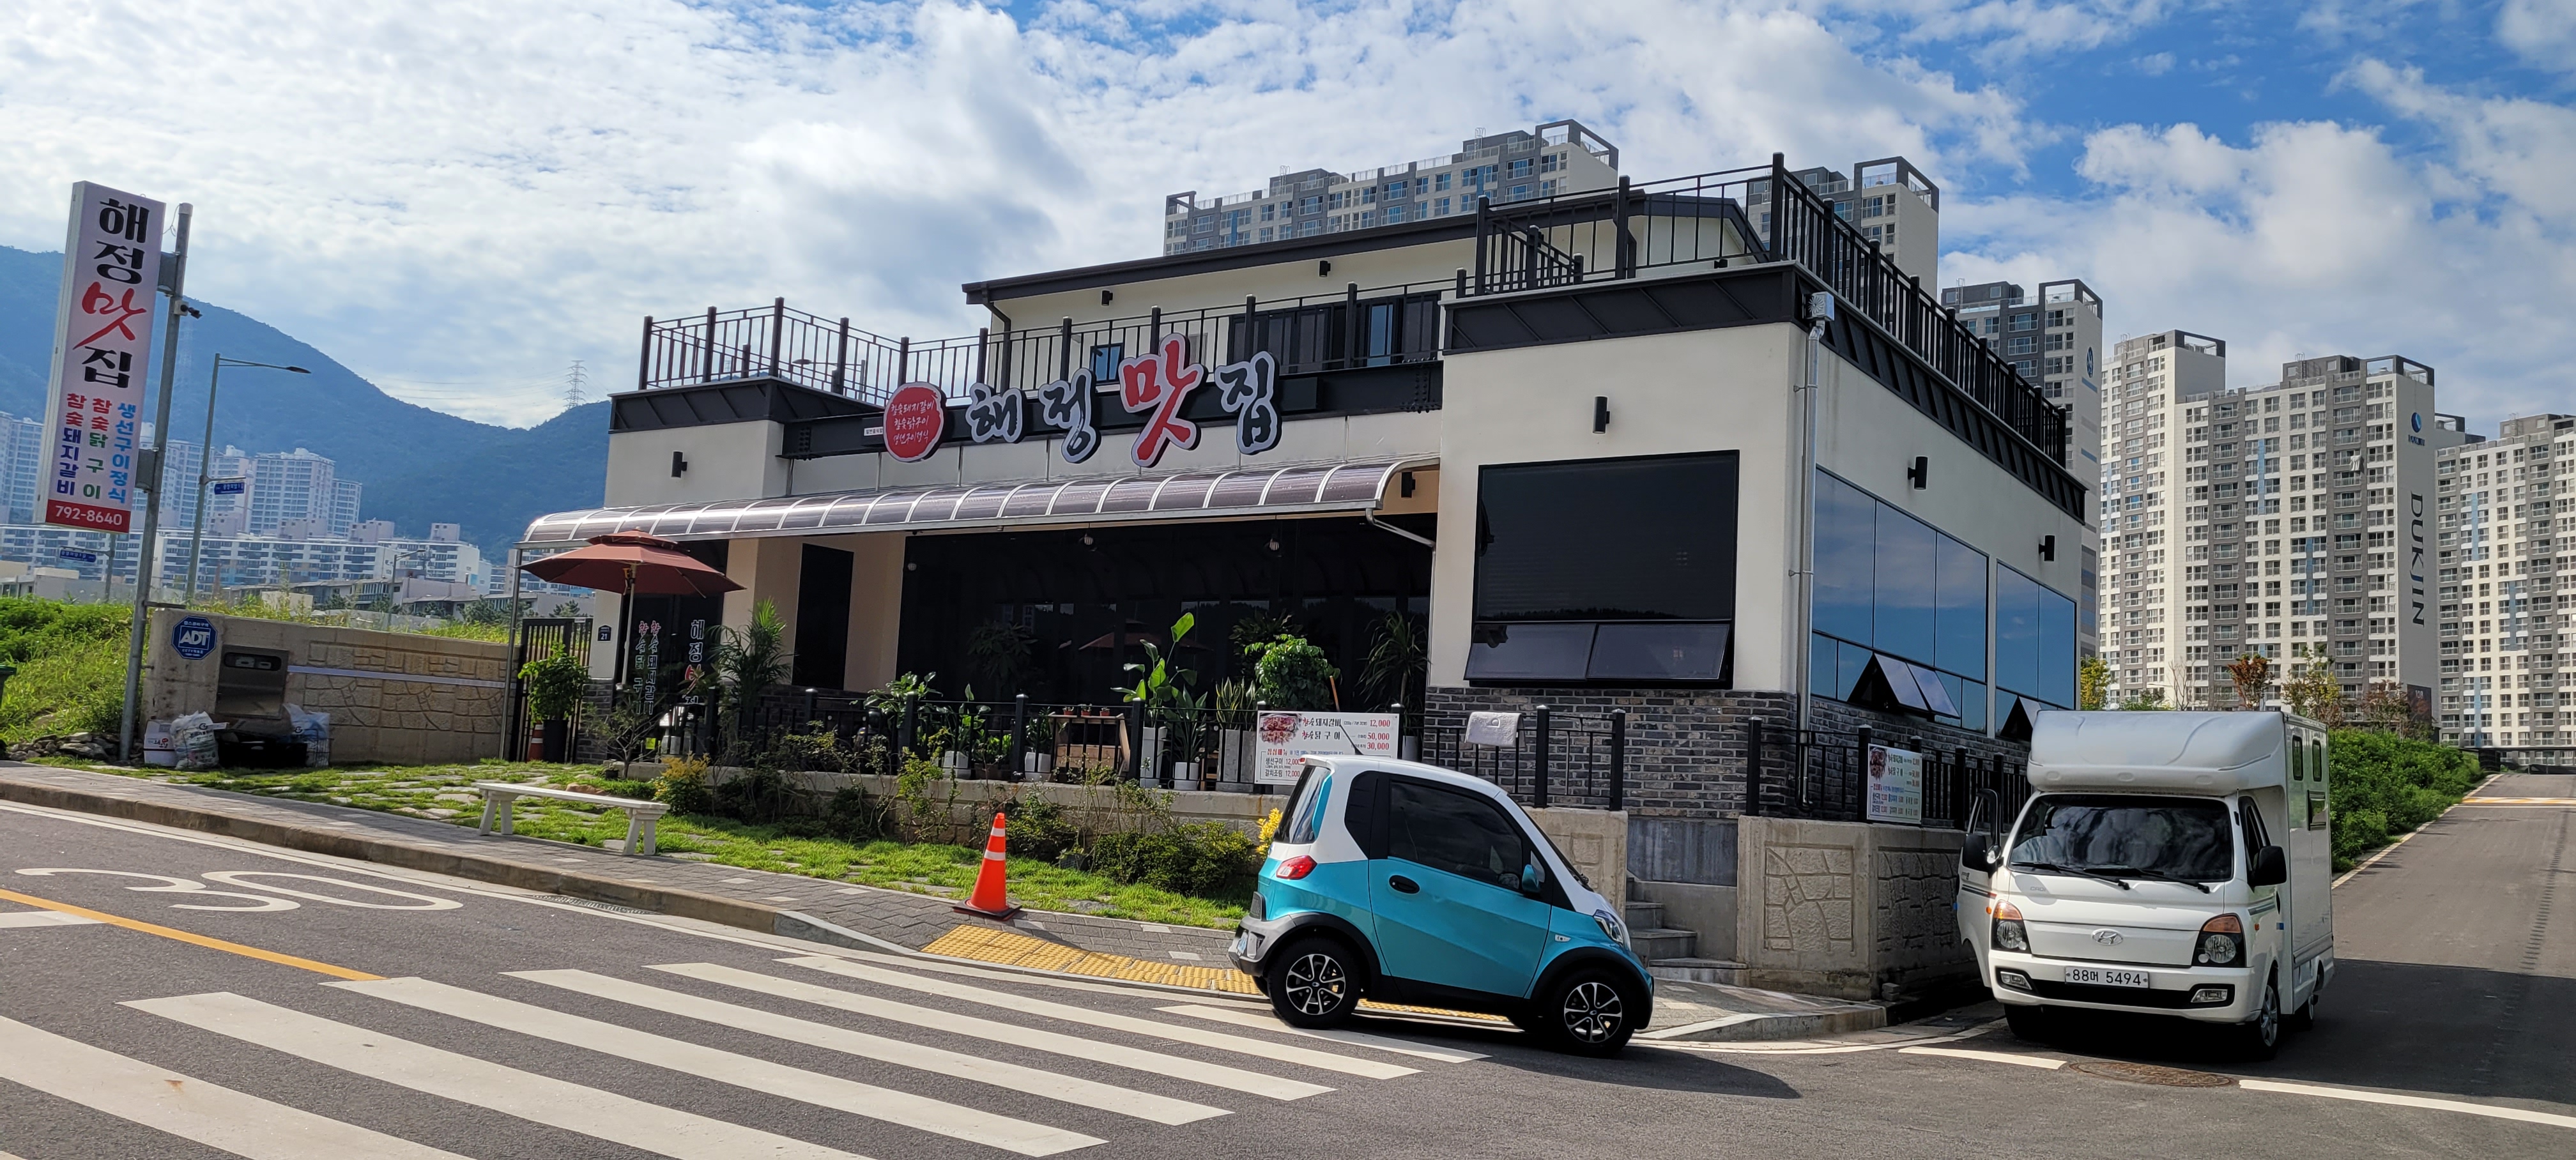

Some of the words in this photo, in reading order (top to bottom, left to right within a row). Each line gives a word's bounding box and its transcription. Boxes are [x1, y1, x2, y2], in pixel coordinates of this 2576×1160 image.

[72, 198, 150, 388] 해정맛집
[967, 336, 1278, 464] 해정맛집
[57, 393, 88, 496] 참숯돼지갈비
[108, 402, 136, 504] 생선구이정식
[55, 505, 122, 526] 792-8640
[180, 630, 210, 646] ADT
[1370, 719, 1391, 728] 12,000
[1367, 732, 1390, 741] 50,000
[1367, 742, 1390, 750] 30,000
[1265, 757, 1284, 766] 생선구이
[15, 867, 463, 912] 30
[2106, 972, 2141, 986] 5494
